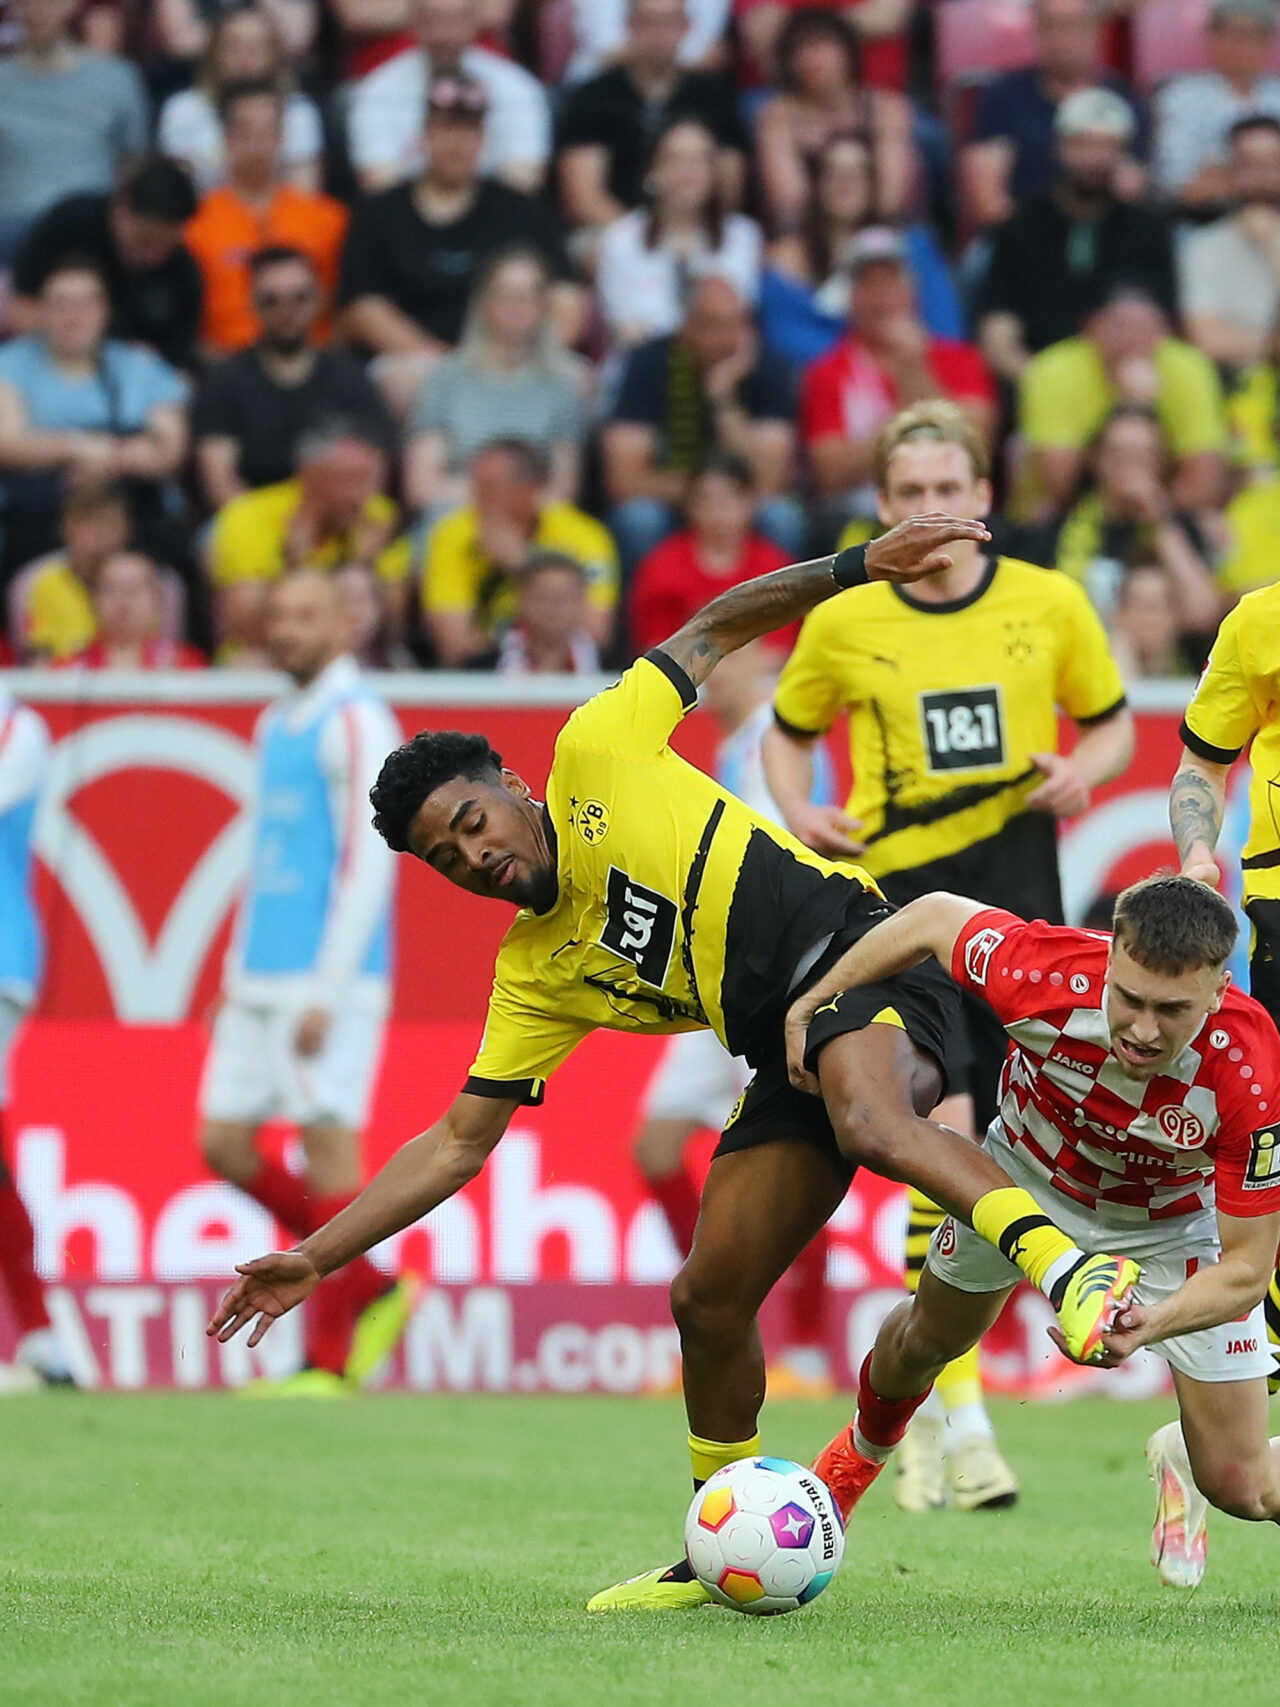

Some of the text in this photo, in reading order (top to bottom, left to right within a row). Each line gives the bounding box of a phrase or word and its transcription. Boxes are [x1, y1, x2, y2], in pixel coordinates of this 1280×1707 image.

[926, 703, 999, 754] 1&1
[1052, 1052, 1094, 1074] JAKO
[1225, 1338, 1258, 1355] JAKO
[799, 1478, 834, 1560] DERBYSTAR
